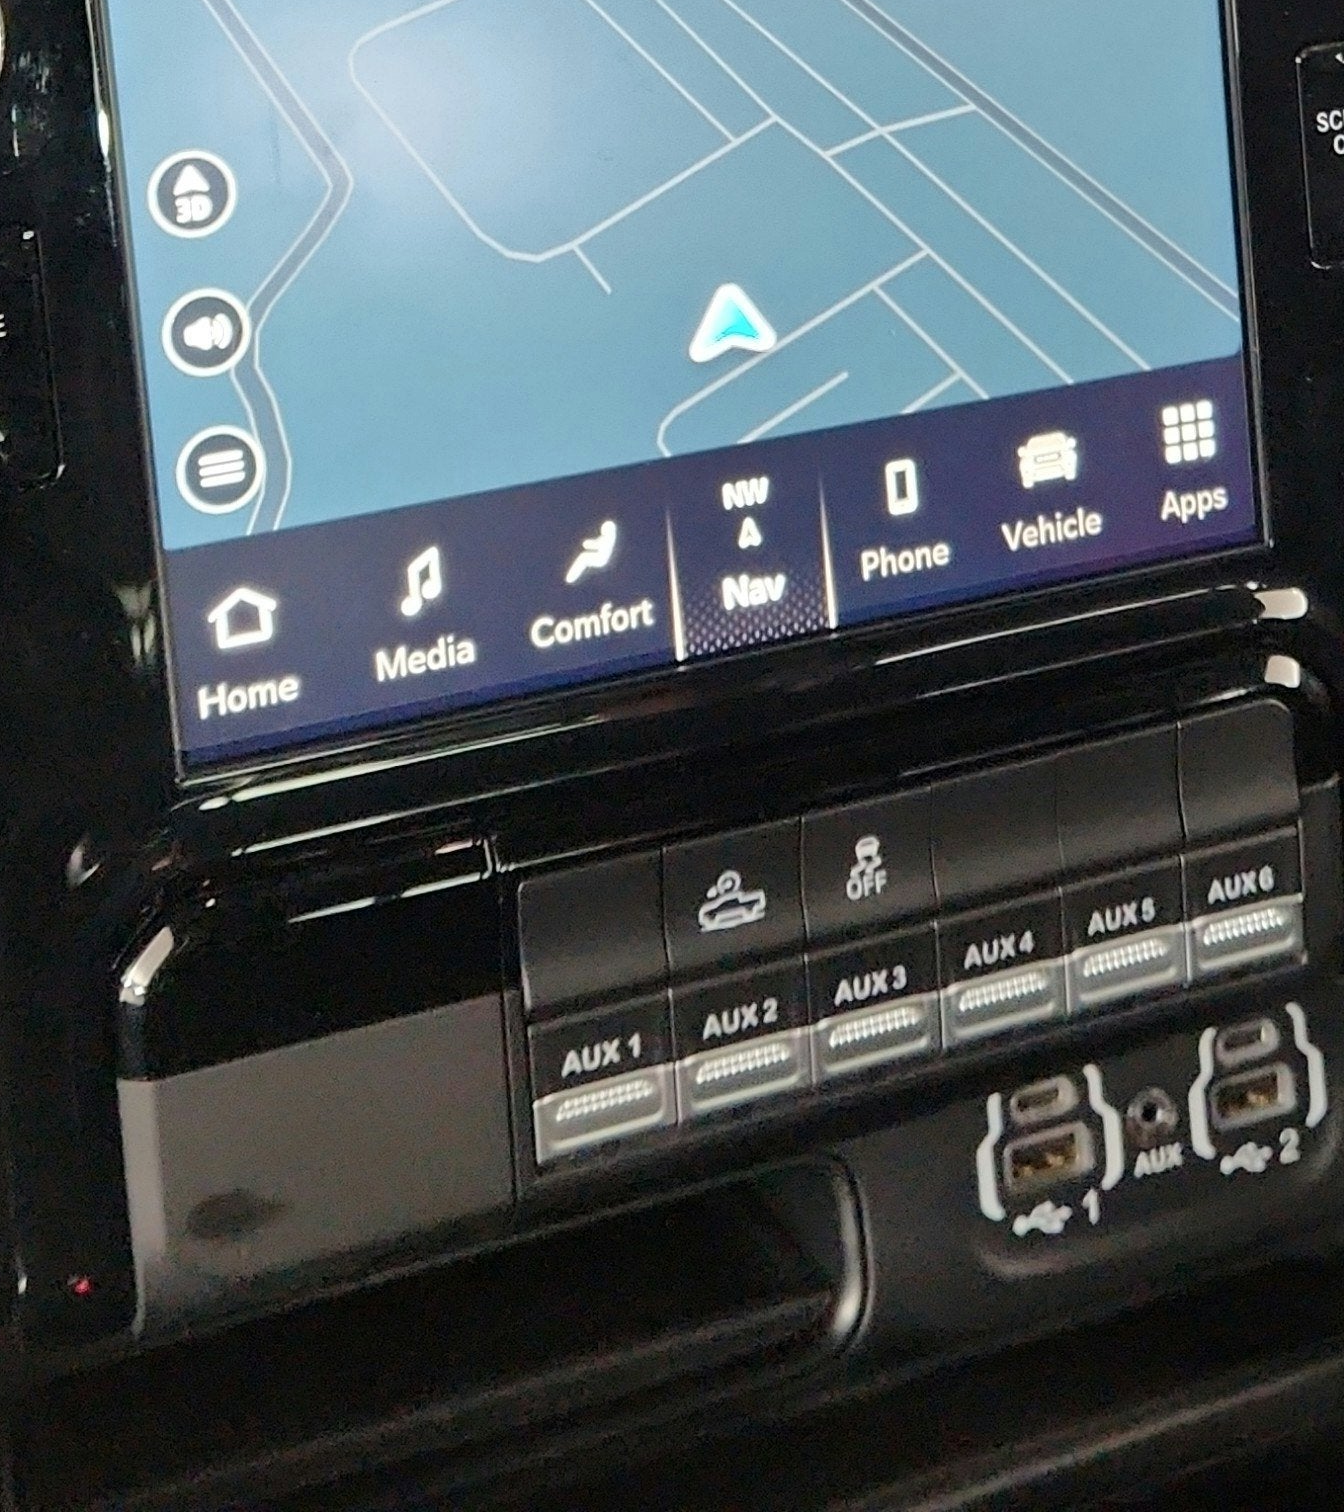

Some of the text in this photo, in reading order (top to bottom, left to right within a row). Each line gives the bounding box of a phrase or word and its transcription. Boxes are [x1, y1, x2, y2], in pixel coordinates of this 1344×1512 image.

[721, 475, 770, 510] NW
[1160, 486, 1229, 525] Apps
[1000, 507, 1103, 552] Vehicle
[860, 541, 951, 581] Phone
[721, 573, 787, 610] Nav
[529, 598, 655, 649] Comfort
[374, 635, 478, 683] Media
[196, 674, 301, 721] Home
[845, 869, 888, 901] OFF
[1206, 864, 1275, 904] AUX 6
[1087, 896, 1157, 937] AUX 5
[963, 930, 1035, 971] AUX 4
[833, 964, 908, 1008] AUX 3
[702, 997, 779, 1041] AUX 2
[561, 1032, 642, 1078] AUX 1
[1133, 1140, 1185, 1178] AUX
[1278, 1126, 1301, 1165] 2
[1082, 1188, 1101, 1225] 1
